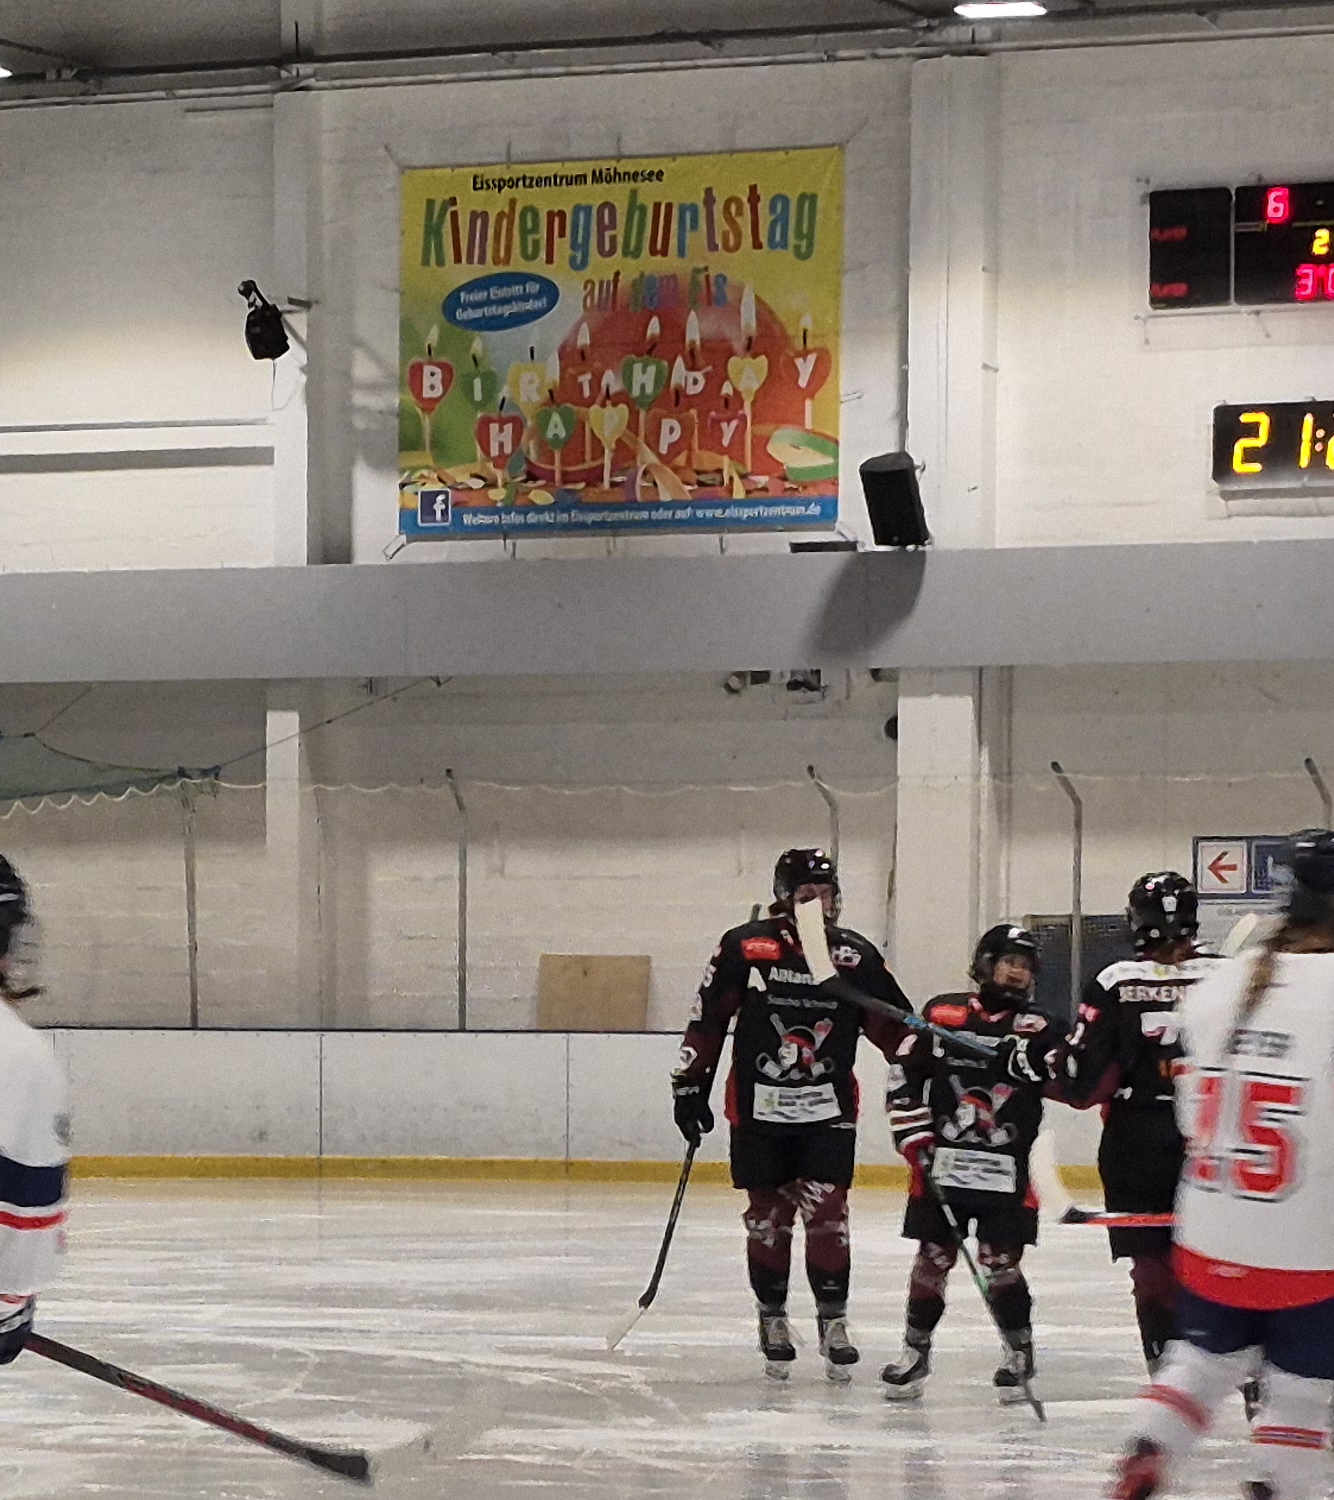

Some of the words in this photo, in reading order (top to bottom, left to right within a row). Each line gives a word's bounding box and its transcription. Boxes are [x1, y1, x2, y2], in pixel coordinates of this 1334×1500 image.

[472, 173, 587, 194] Eissportzentrum
[591, 167, 665, 186] Möhnesee
[1267, 187, 1290, 223] 6
[421, 184, 818, 272] Kindergeburtstag
[1312, 228, 1331, 256] 2
[747, 966, 767, 992] A
